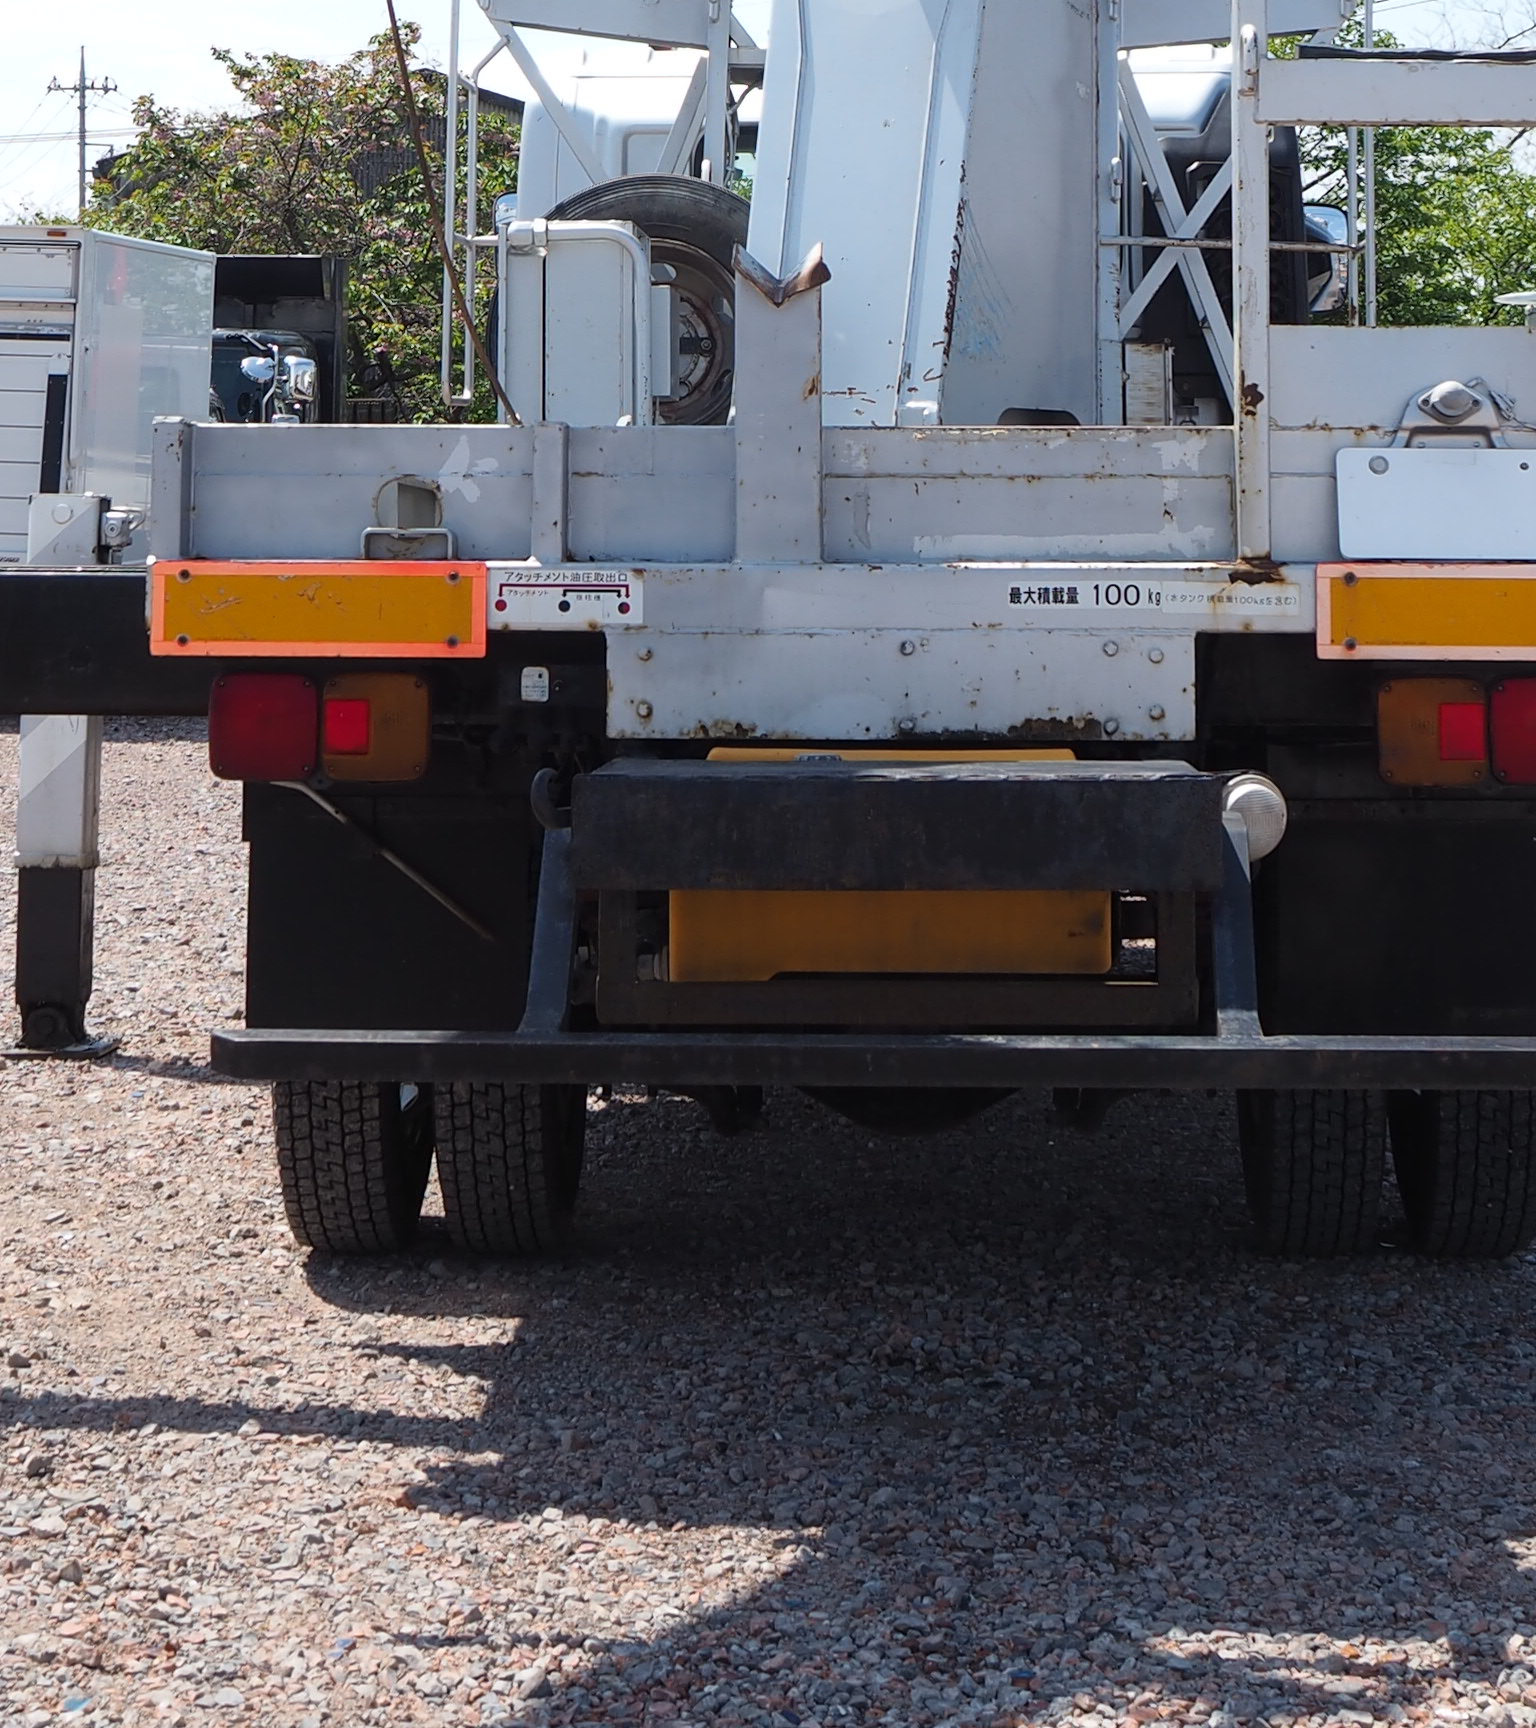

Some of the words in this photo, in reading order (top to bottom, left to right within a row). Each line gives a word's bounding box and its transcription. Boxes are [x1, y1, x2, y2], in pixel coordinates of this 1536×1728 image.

[504, 571, 628, 583] アタッチメント油圧取出口
[1009, 587, 1079, 605] 最大積載量
[1093, 583, 1141, 606] 100
[1148, 588, 1161, 606] kg
